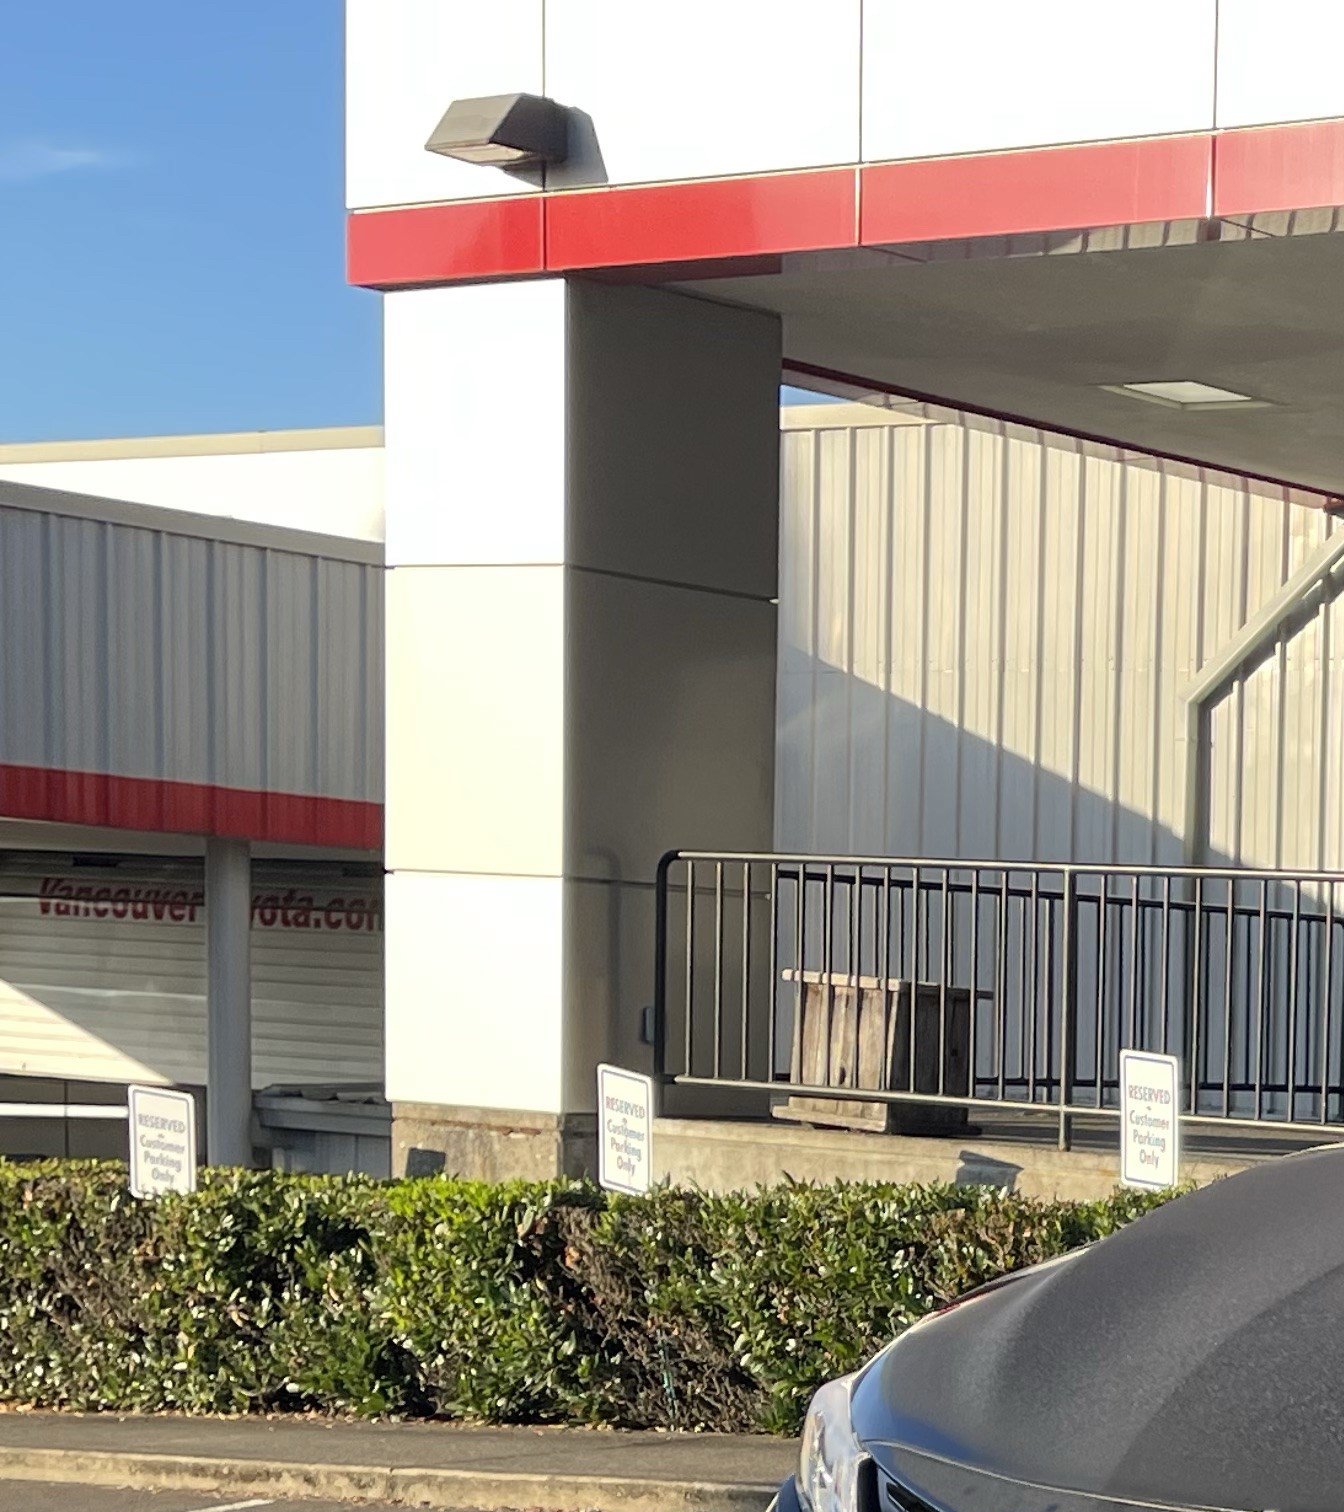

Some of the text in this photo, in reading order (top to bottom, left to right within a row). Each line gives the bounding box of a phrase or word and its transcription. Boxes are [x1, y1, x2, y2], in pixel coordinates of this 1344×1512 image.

[1128, 1084, 1171, 1105] RESERVED
[605, 1095, 646, 1120] RESERVED
[138, 1113, 187, 1134] RESERVED
[606, 1118, 645, 1142] Customer
[1129, 1109, 1170, 1131] Customer
[140, 1134, 185, 1154] Customer
[610, 1136, 642, 1163] Parking
[1133, 1129, 1166, 1153] Parking
[144, 1151, 182, 1173] Parking
[616, 1155, 636, 1177] Only
[1139, 1149, 1160, 1169] Only
[152, 1167, 175, 1187] Only
